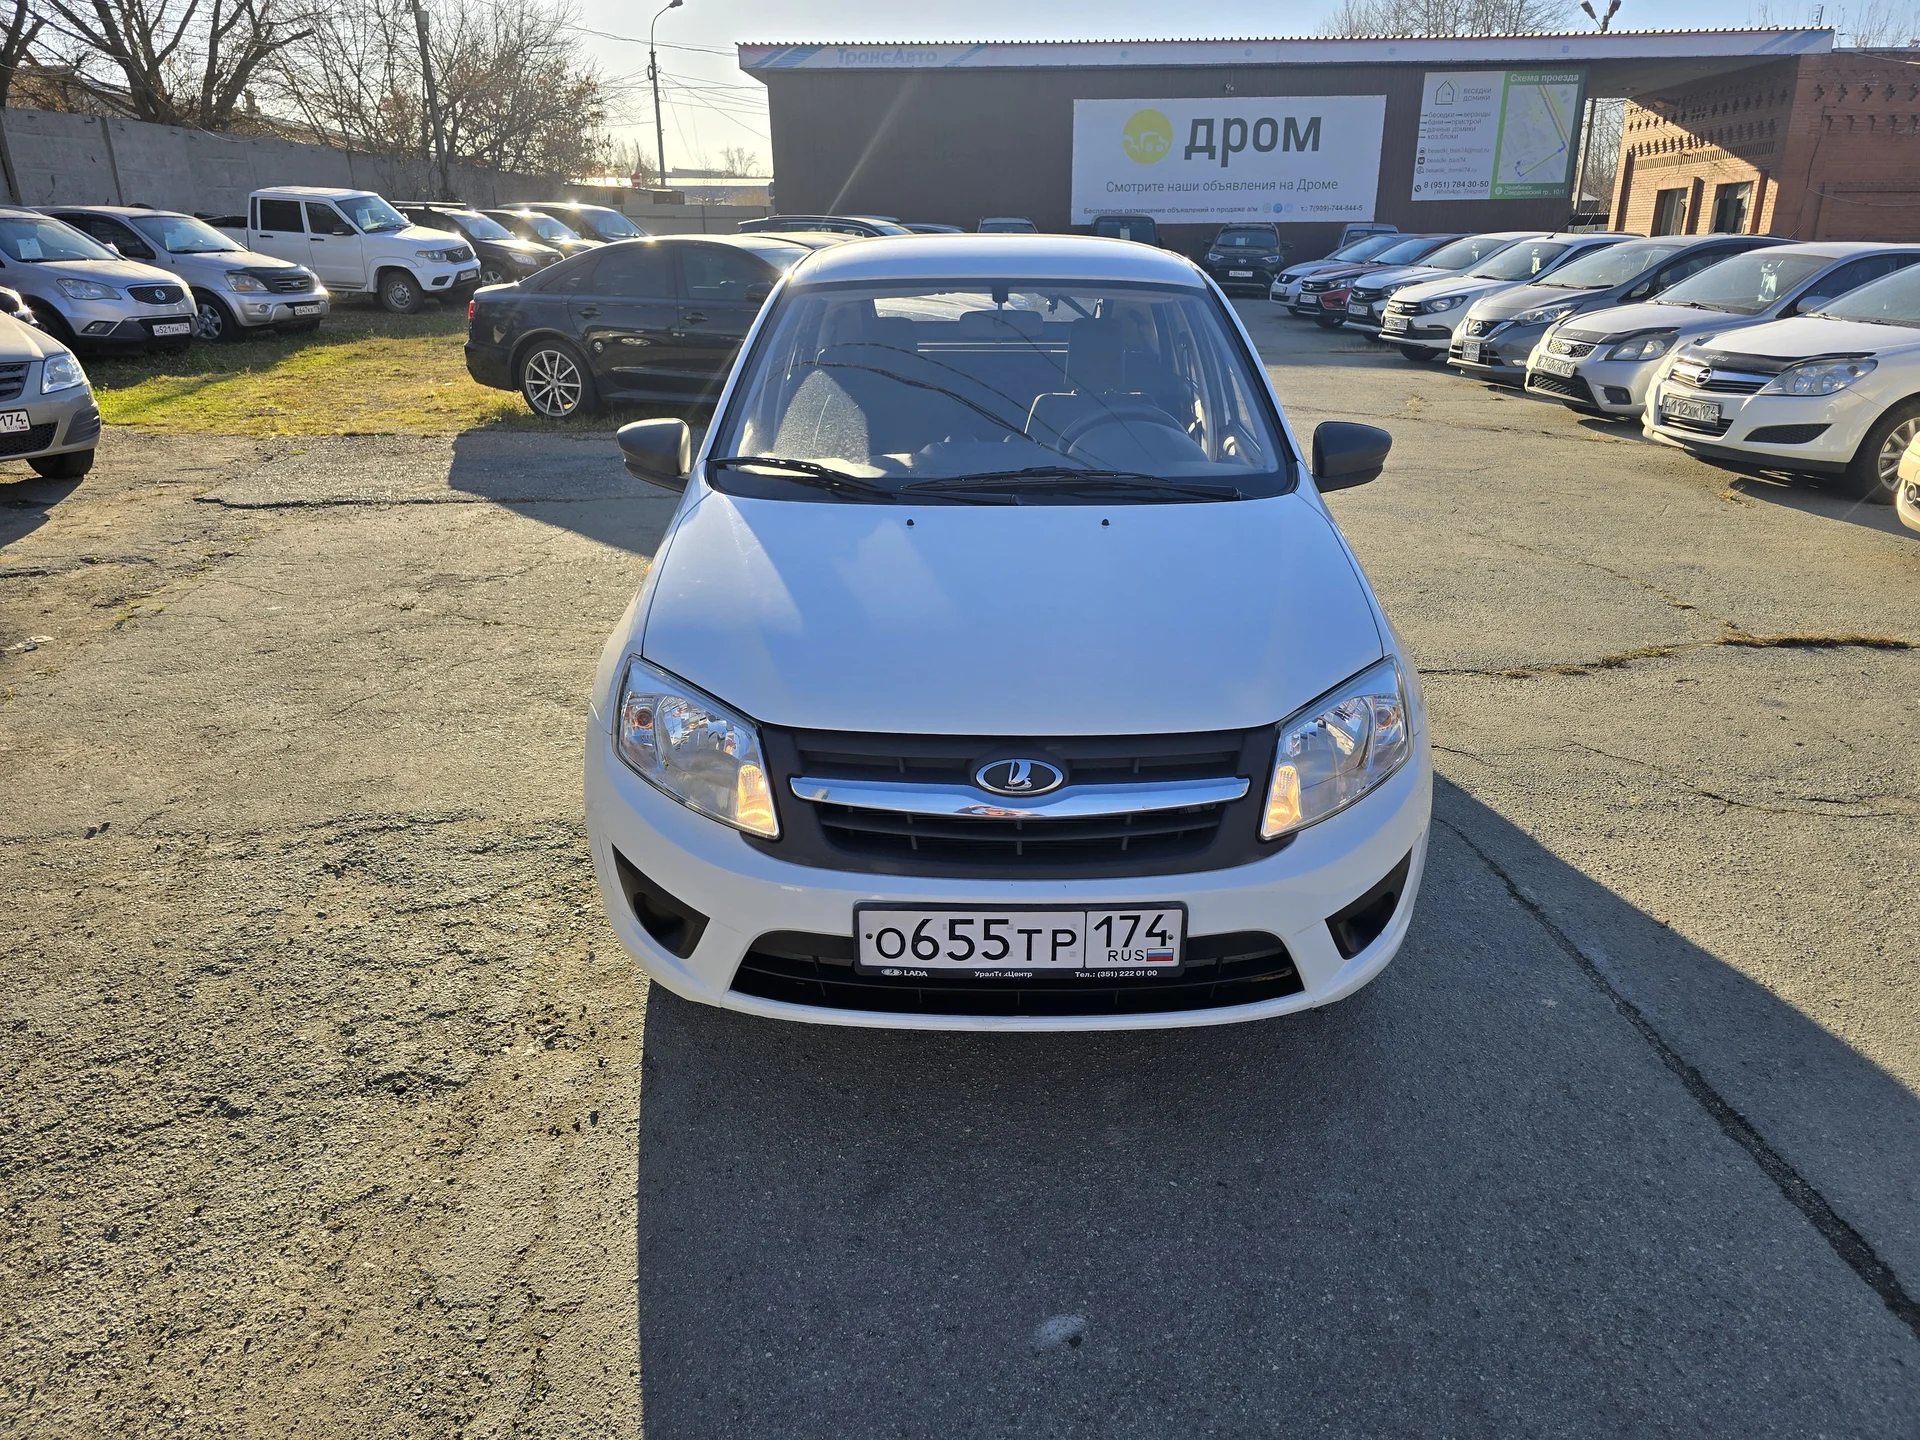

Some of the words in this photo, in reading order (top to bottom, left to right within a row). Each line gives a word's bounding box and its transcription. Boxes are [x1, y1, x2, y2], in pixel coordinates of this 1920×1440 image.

[837, 48, 937, 65] ТрансАвто
[1510, 73, 1539, 82] Схема
[1541, 74, 1579, 83] проезда
[1428, 111, 1455, 119] беседки
[1451, 118, 1482, 126] пристрой
[1184, 116, 1322, 168] дром
[1106, 180, 1165, 195] Смотрите
[1167, 182, 1200, 192] наши
[1203, 179, 1276, 192] объявления
[1278, 181, 1294, 191] на
[1297, 178, 1338, 192] Дроме
[1424, 181, 1429, 189] 8
[1430, 181, 1450, 190] (951)
[1467, 180, 1489, 188] 30-50
[1125, 206, 1166, 214] размещение
[1167, 205, 1209, 214] объявлений
[1216, 206, 1246, 214] продаже
[1247, 205, 1258, 213] а/м
[1093, 914, 1168, 949] 174
[1107, 949, 1145, 962] RUS
[1075, 971, 1095, 979] Тел.:
[1097, 971, 1117, 979] (351)
[1119, 970, 1134, 978] 222
[1146, 969, 1158, 977] 00
